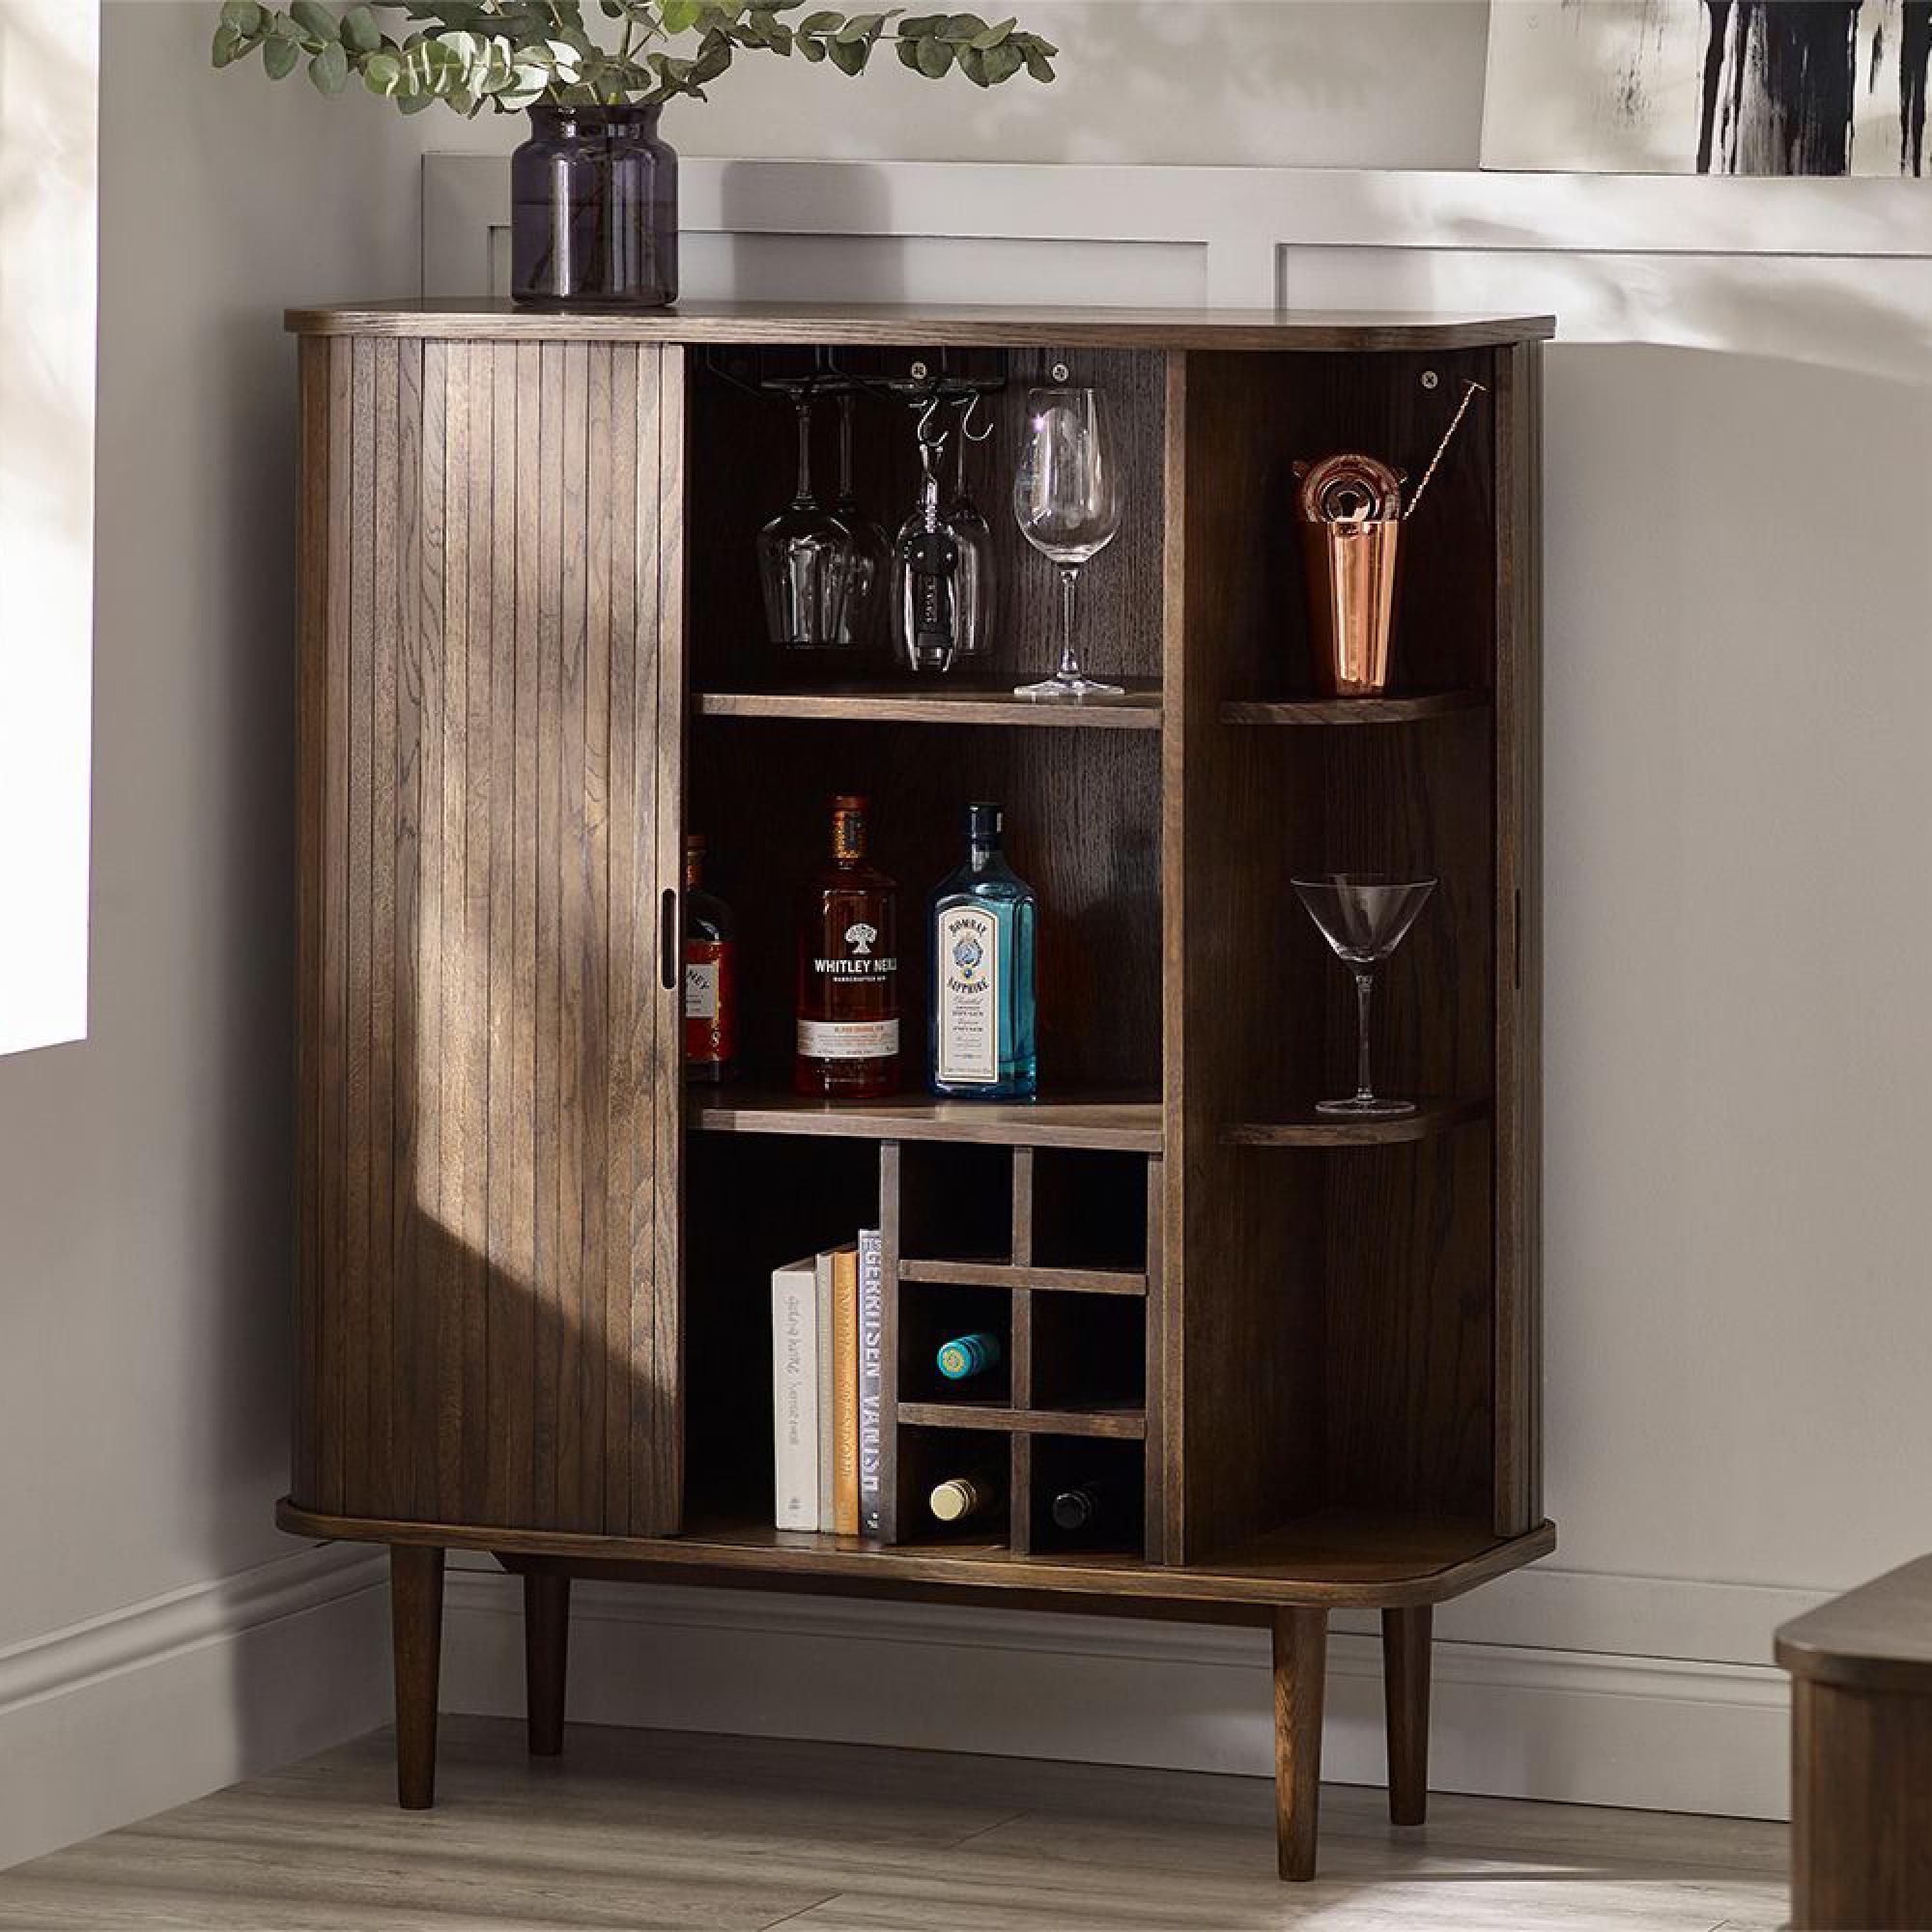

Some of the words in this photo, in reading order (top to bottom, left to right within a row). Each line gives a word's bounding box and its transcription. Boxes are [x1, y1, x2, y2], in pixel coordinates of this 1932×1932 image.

[814, 959, 871, 973] WHITLEY
[865, 1251, 882, 1378] GERRITSEN
[862, 1394, 881, 1492] VANISH
